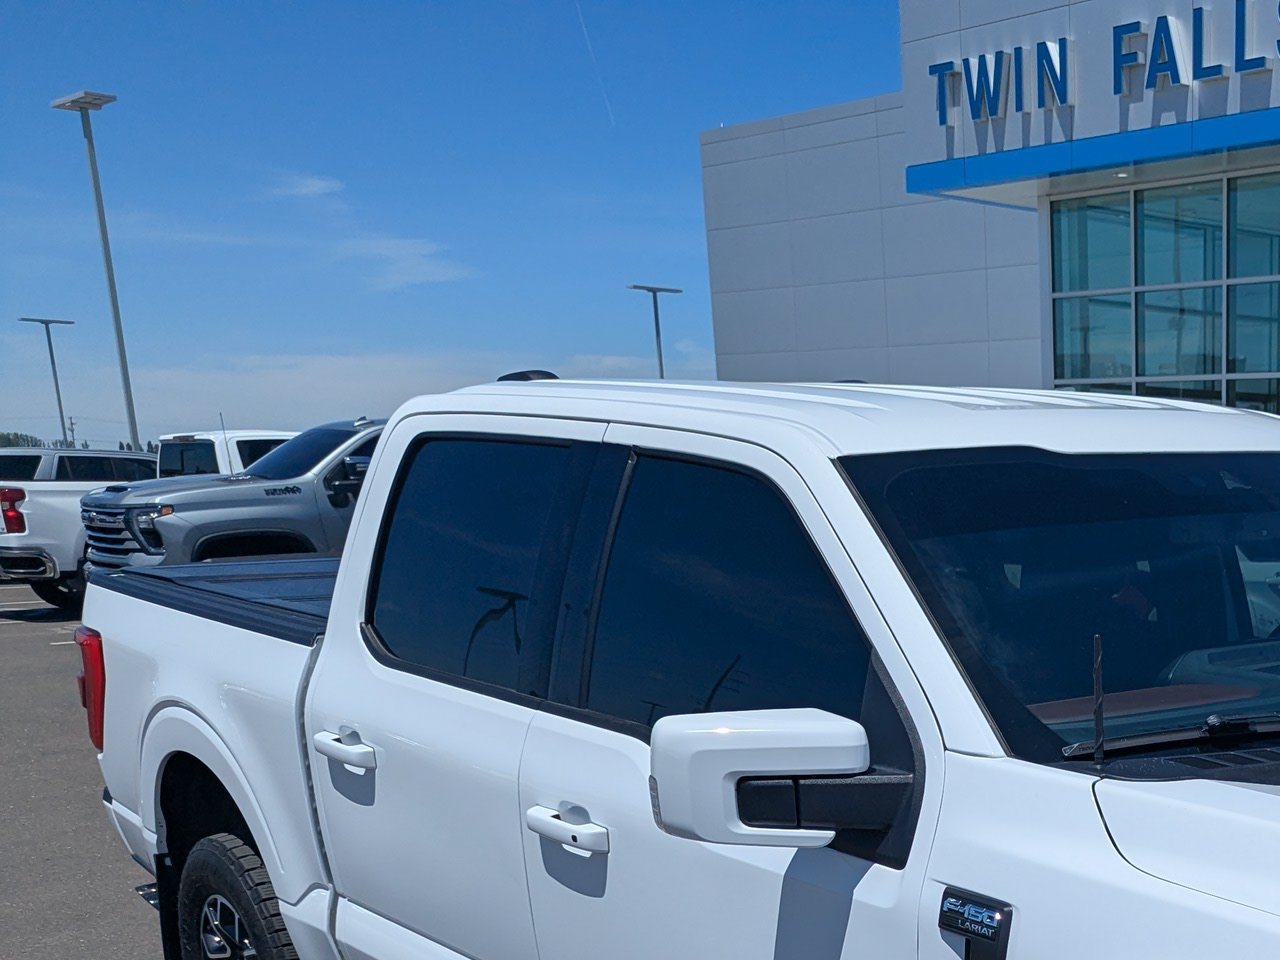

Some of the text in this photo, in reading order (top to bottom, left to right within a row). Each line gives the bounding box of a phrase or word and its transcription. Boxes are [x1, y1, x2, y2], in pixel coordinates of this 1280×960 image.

[928, 37, 1068, 126] TWIN
[943, 897, 1000, 927] F-150
[958, 919, 995, 937] LARIAT
